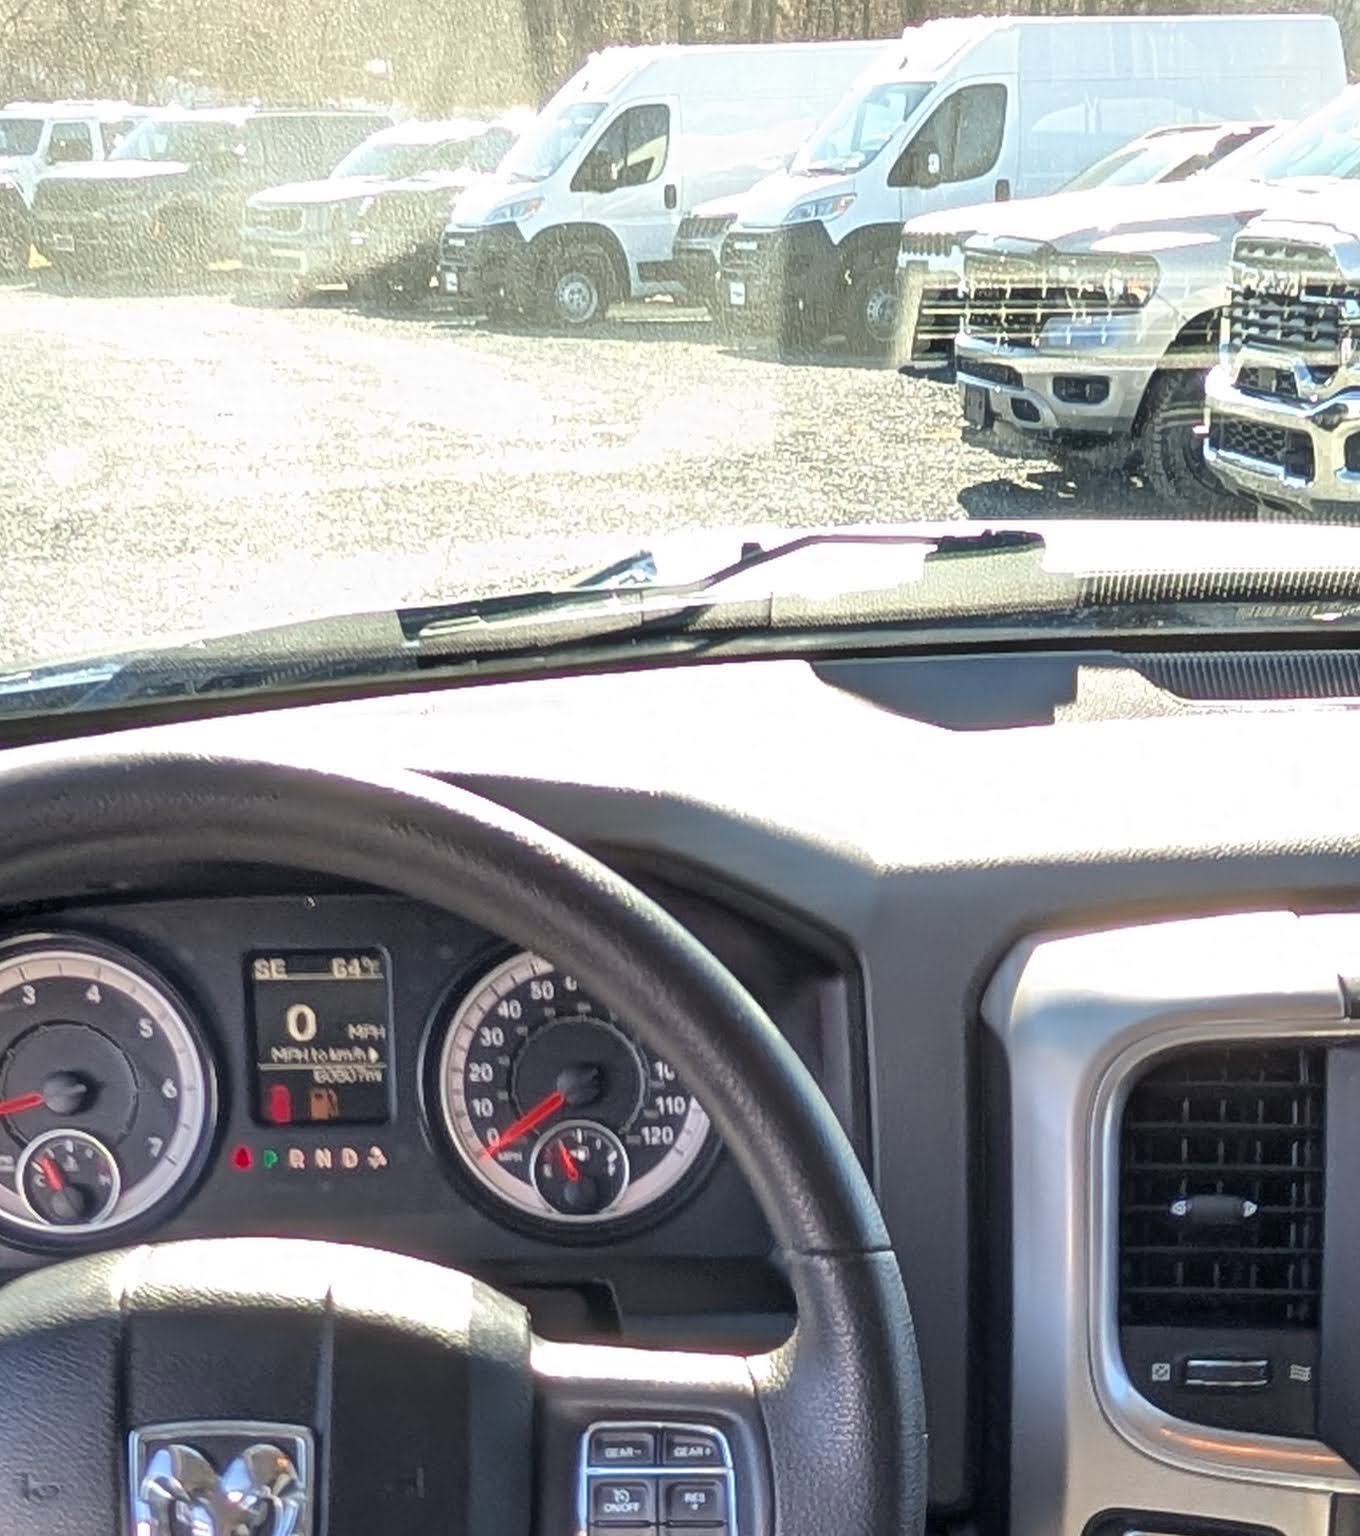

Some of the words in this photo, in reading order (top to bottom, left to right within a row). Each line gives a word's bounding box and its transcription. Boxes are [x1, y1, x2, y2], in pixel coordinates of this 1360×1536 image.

[22, 985, 36, 1005] 3
[86, 985, 102, 1004] 4
[530, 980, 554, 1000] 50
[498, 1000, 522, 1019] 40
[139, 1021, 154, 1039] 5
[286, 1003, 318, 1042] 0
[480, 1026, 504, 1048] 30
[469, 1062, 493, 1082] 20
[162, 1078, 178, 1099] 6
[472, 1098, 493, 1117] 10
[655, 1096, 686, 1115] 110
[641, 1126, 674, 1145] 120
[263, 1149, 278, 1168] P
[290, 1149, 305, 1169] R
[315, 1148, 332, 1169] N
[342, 1148, 359, 1169] D
